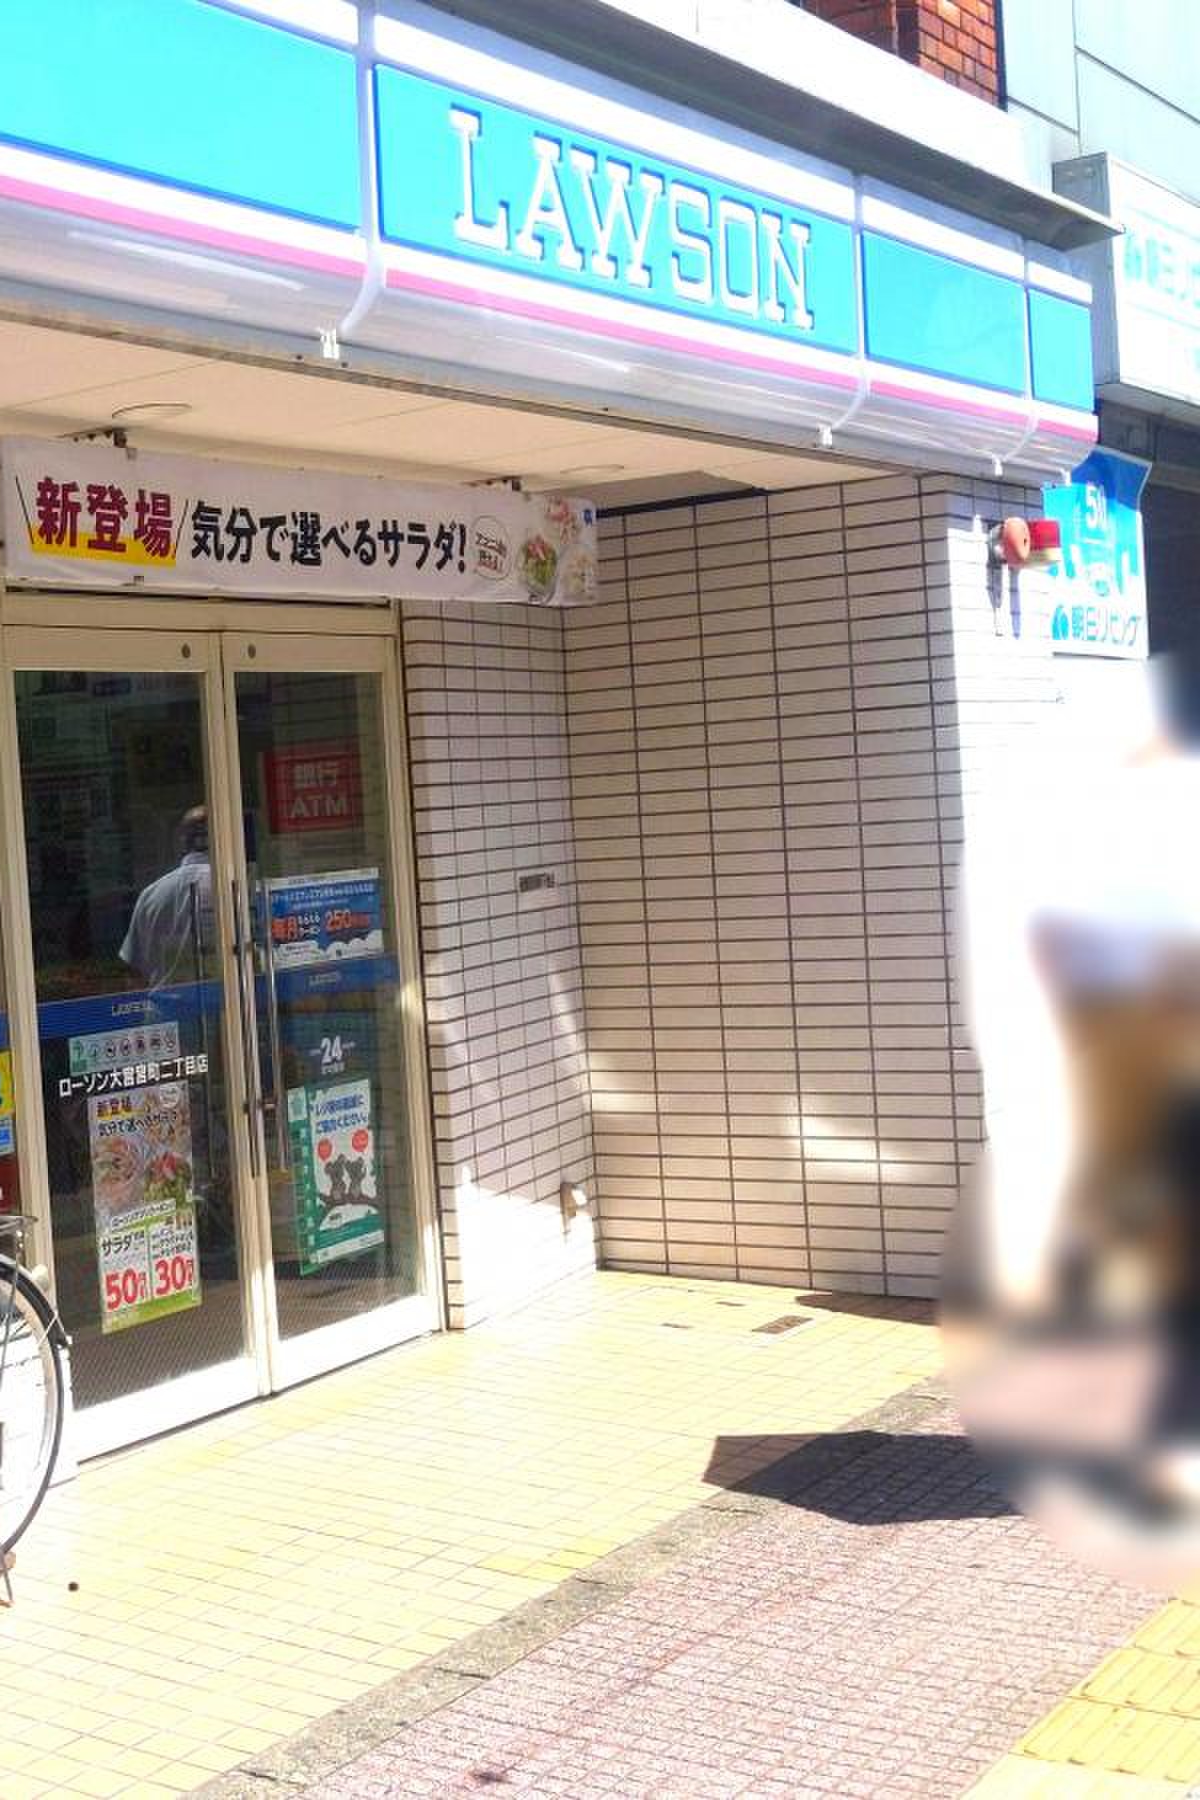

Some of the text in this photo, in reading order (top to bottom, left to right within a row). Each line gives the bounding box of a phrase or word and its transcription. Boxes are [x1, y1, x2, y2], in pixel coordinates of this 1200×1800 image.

[449, 102, 814, 331] LAWSON
[35, 476, 176, 560] 新登場
[290, 794, 347, 818] ATM
